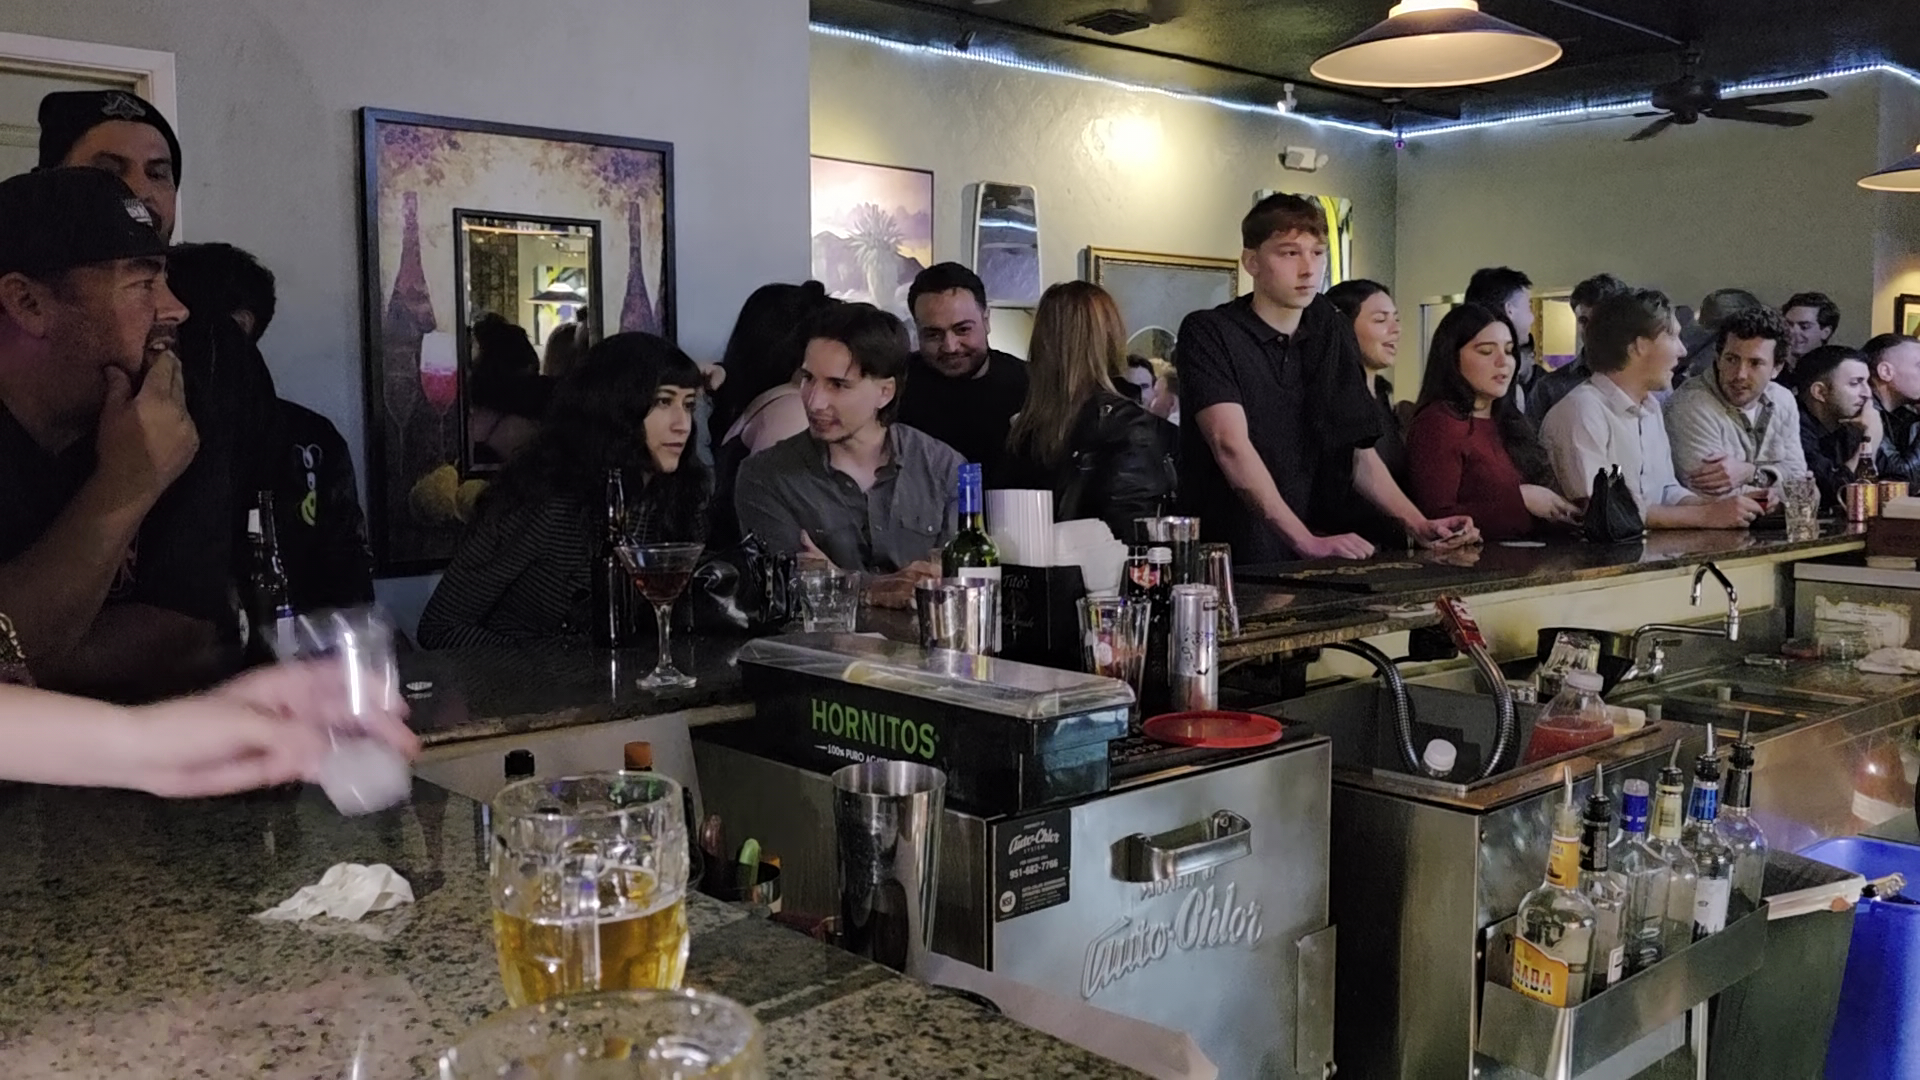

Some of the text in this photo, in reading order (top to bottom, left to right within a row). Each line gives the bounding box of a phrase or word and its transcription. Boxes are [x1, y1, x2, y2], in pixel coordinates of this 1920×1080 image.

[811, 698, 935, 760] HORNITOS
[846, 748, 865, 763] PURO
[1081, 881, 1264, 1000] Auto-Chlor
